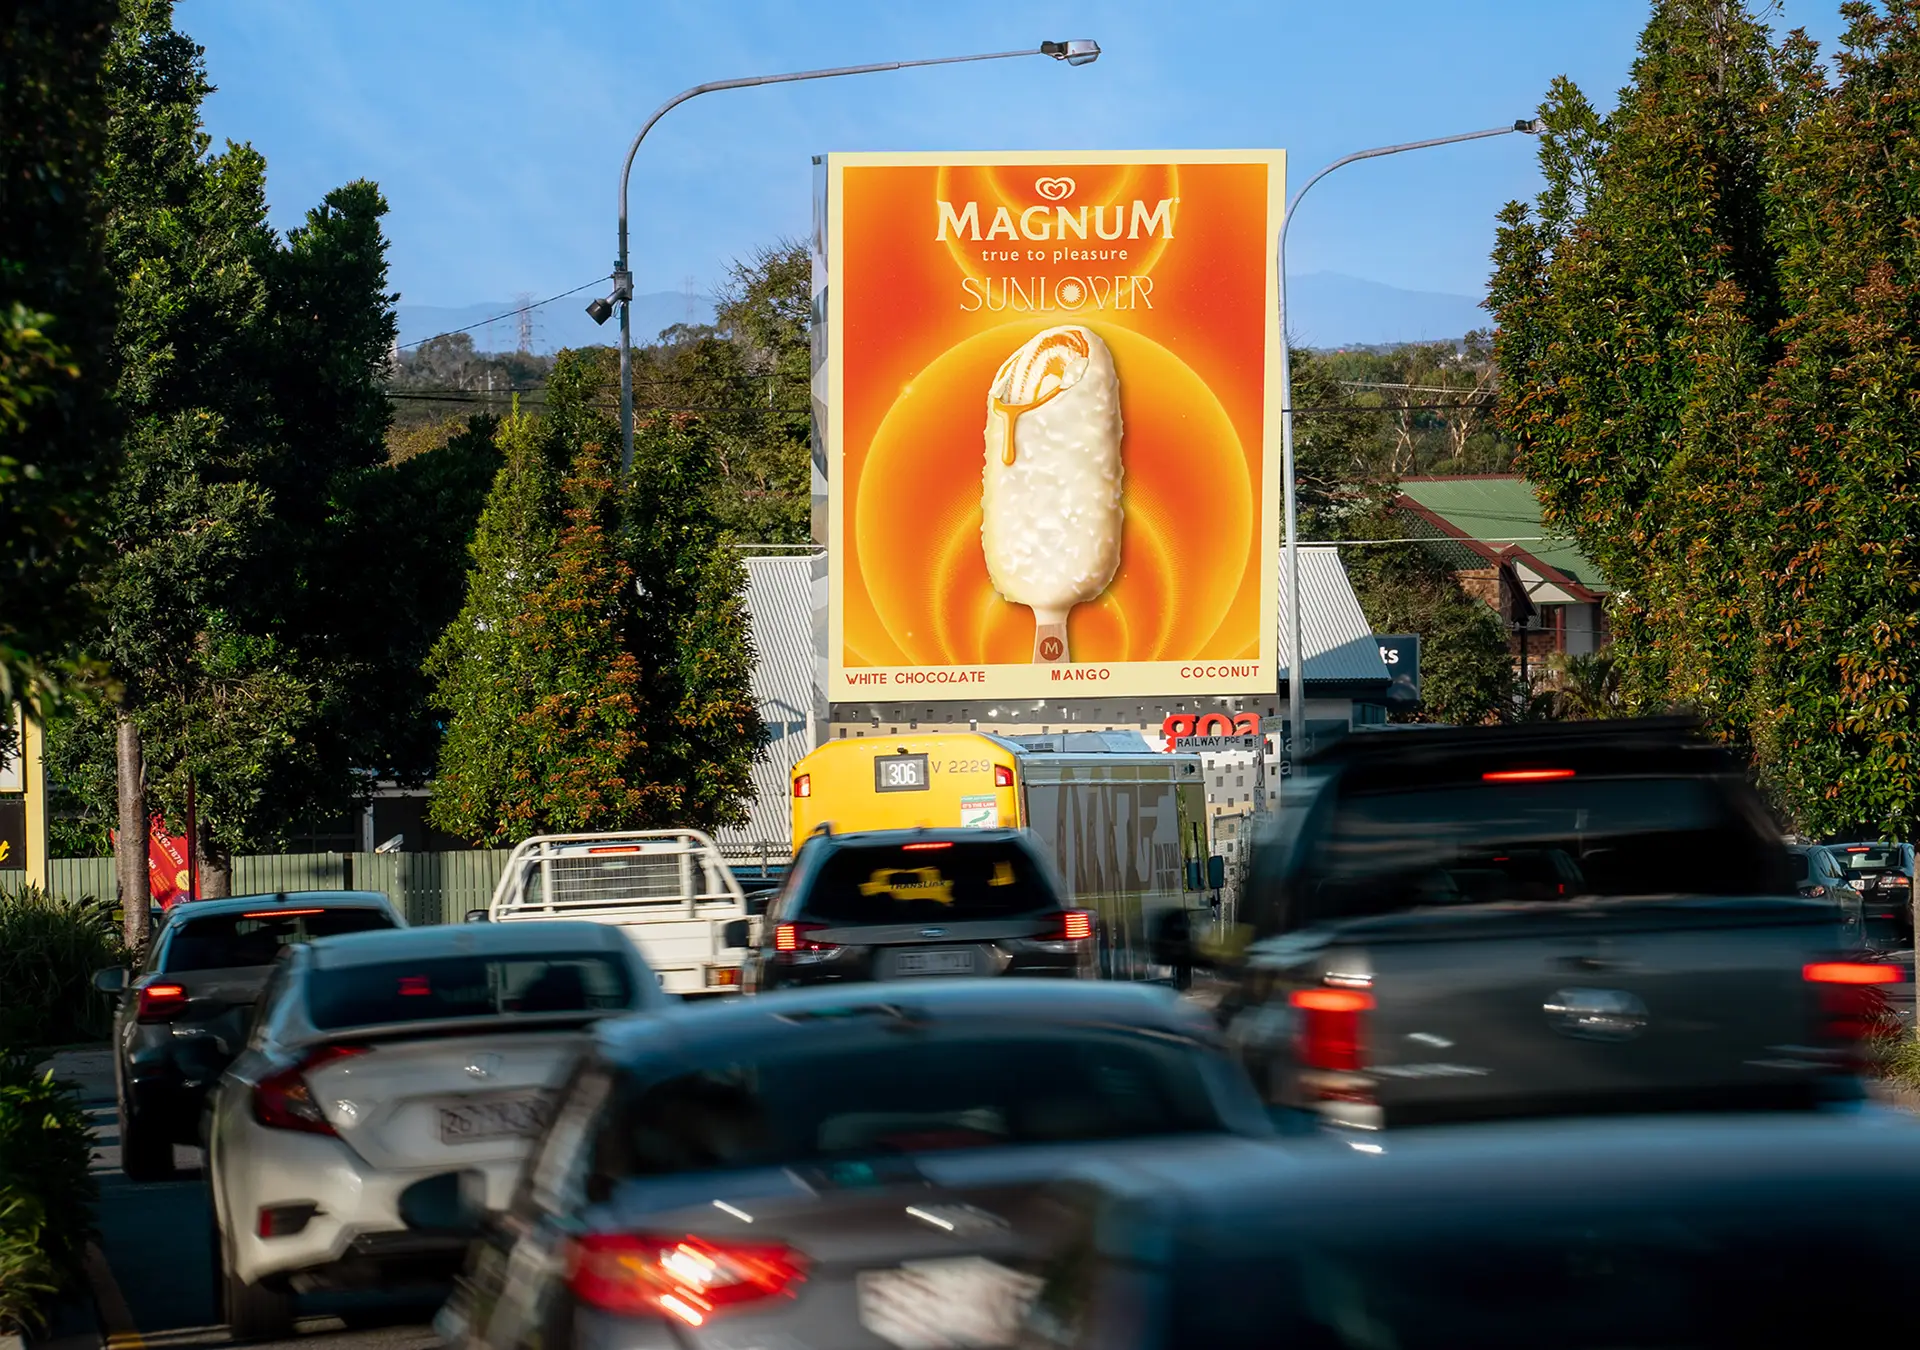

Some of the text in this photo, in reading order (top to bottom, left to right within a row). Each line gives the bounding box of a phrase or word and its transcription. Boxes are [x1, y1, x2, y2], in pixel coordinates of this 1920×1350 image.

[982, 247, 1128, 264] true to pleasure
[960, 275, 1154, 312] SUNLOVER
[1045, 642, 1059, 655] M
[846, 671, 985, 685] WHITE CHOCOLATE
[1051, 668, 1110, 681] MANGO
[1180, 665, 1260, 679] COCONUT
[1162, 712, 1262, 753] goa
[1177, 737, 1220, 748] RAILWAY
[949, 760, 991, 773] 2229
[889, 763, 916, 785] 306
